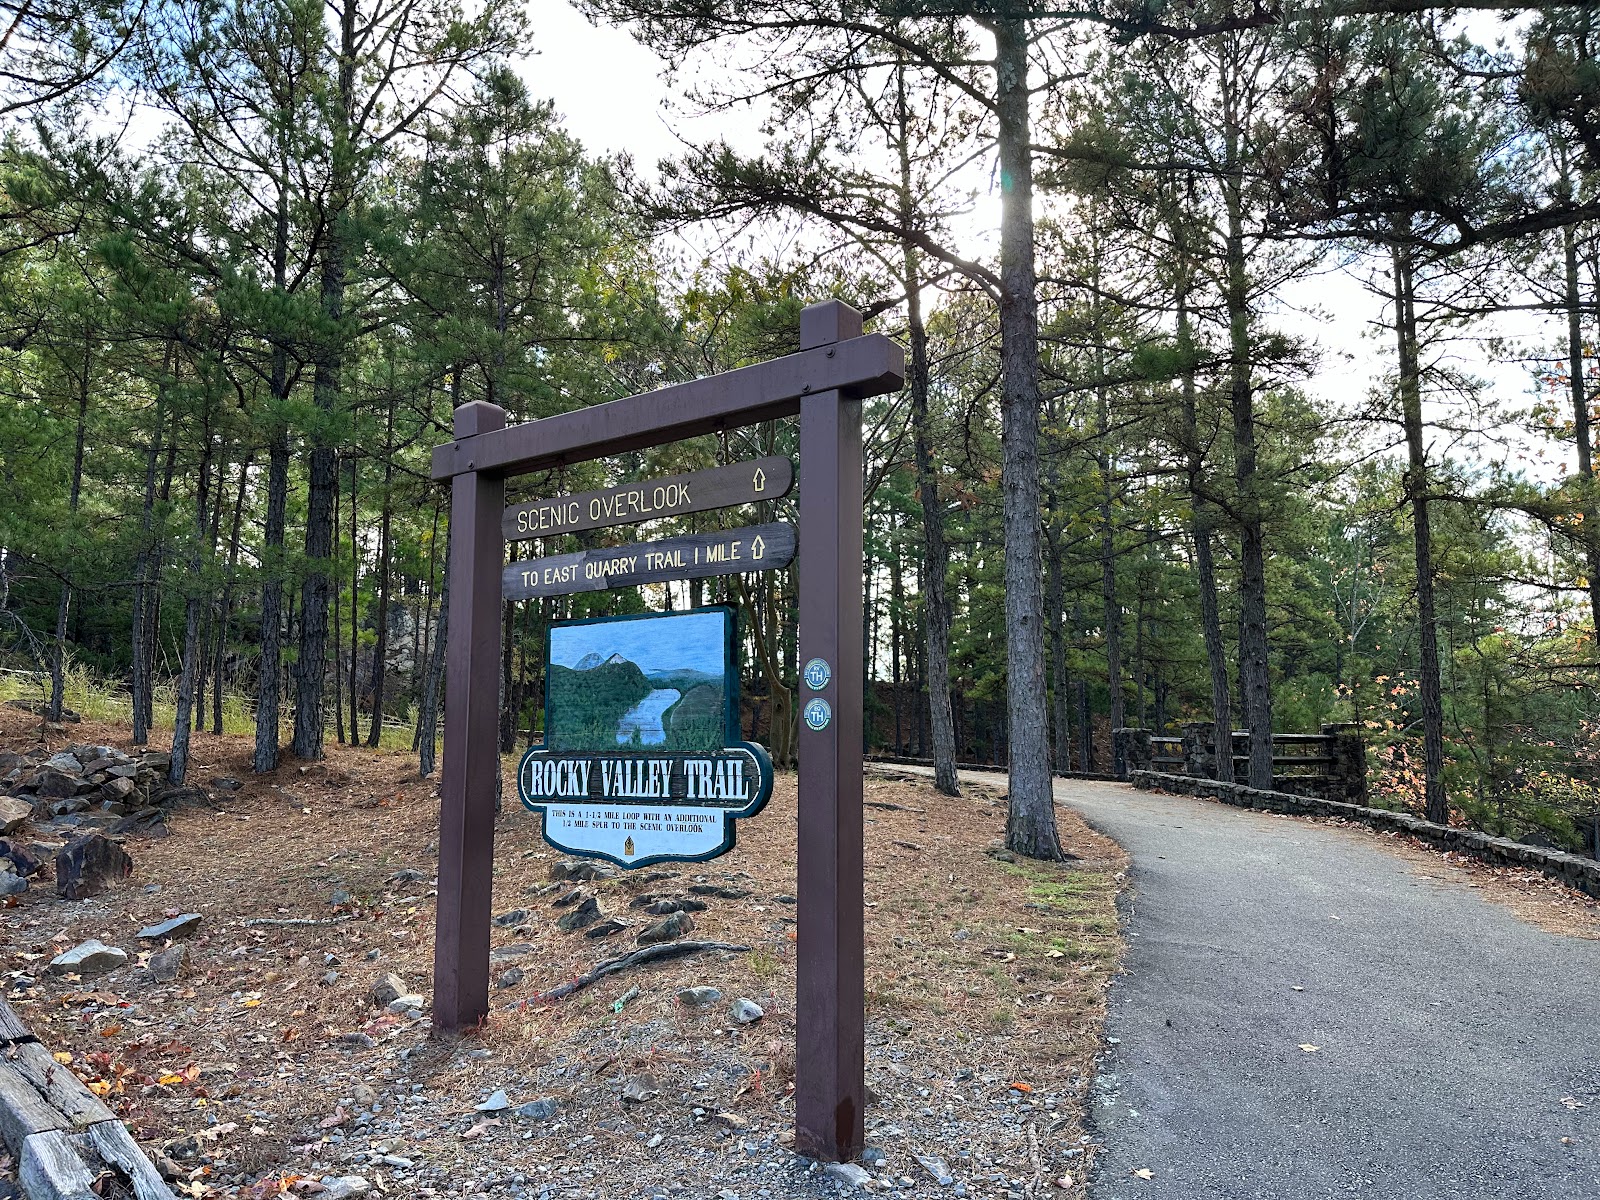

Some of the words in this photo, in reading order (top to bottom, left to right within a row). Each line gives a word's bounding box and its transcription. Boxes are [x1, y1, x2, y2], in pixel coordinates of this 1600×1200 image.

[517, 502, 579, 532] SCENIC
[589, 482, 692, 521] OVERLOOK
[521, 570, 538, 587] TO
[544, 564, 578, 585] EAST
[585, 555, 637, 579] QUARRY
[644, 550, 686, 570] TRAIL
[706, 540, 741, 563] MILE
[810, 671, 823, 681] TH
[811, 711, 824, 721] TH
[530, 760, 592, 796] ROCKY
[600, 760, 673, 798] VALLEY
[683, 759, 749, 800] TRAIL
[552, 809, 566, 818] THIS
[569, 810, 575, 818] IS
[585, 811, 601, 820] 1-1/2
[604, 811, 619, 820] MILE
[622, 812, 640, 820] LOOP
[643, 812, 660, 821] WITH
[663, 813, 672, 821] AN
[674, 813, 717, 823] ADDITIONAL
[563, 819, 571, 828] 1/2
[574, 820, 589, 828] MILE
[592, 820, 608, 829] SPUR
[612, 821, 620, 829] TO
[623, 822, 636, 830] THE
[640, 822, 663, 832] SCENIC
[666, 823, 703, 833] OVERLOOK
